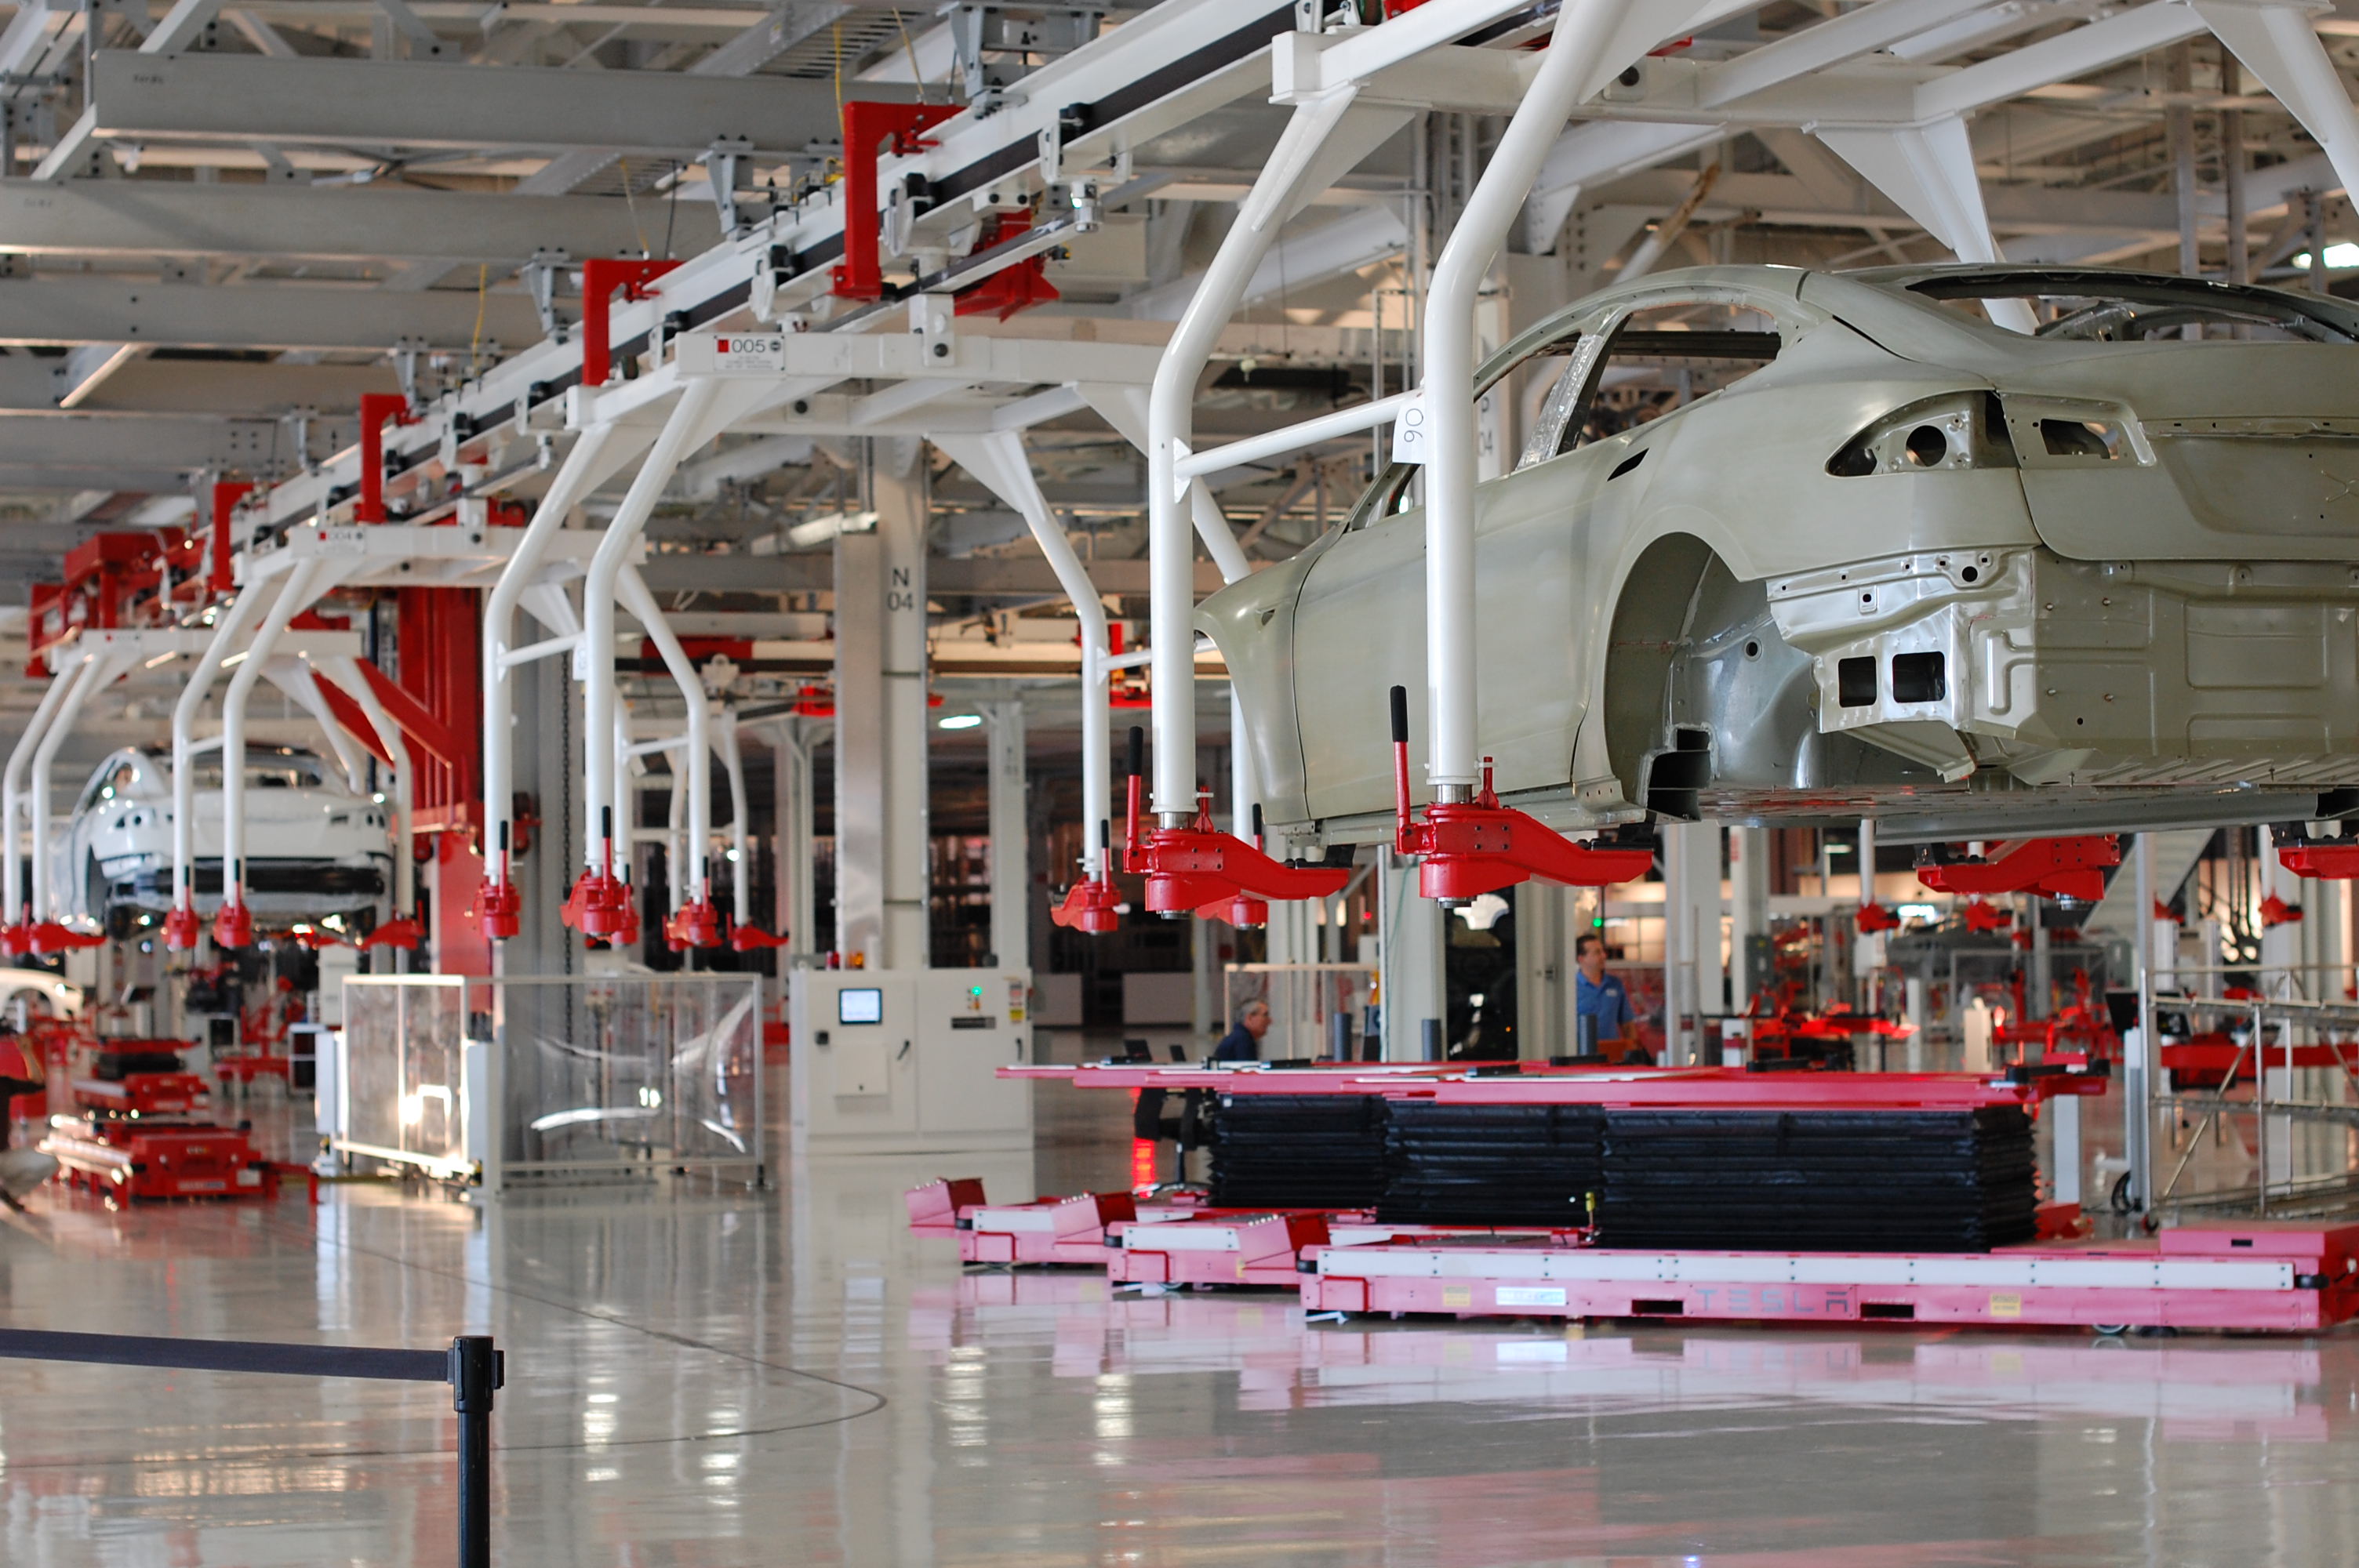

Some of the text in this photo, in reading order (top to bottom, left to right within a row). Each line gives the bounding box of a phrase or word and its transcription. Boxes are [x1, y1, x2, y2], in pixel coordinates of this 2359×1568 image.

[732, 339, 765, 353] 005
[892, 567, 910, 587] N
[887, 590, 914, 612] 04
[1695, 1289, 1849, 1313] TESLA
